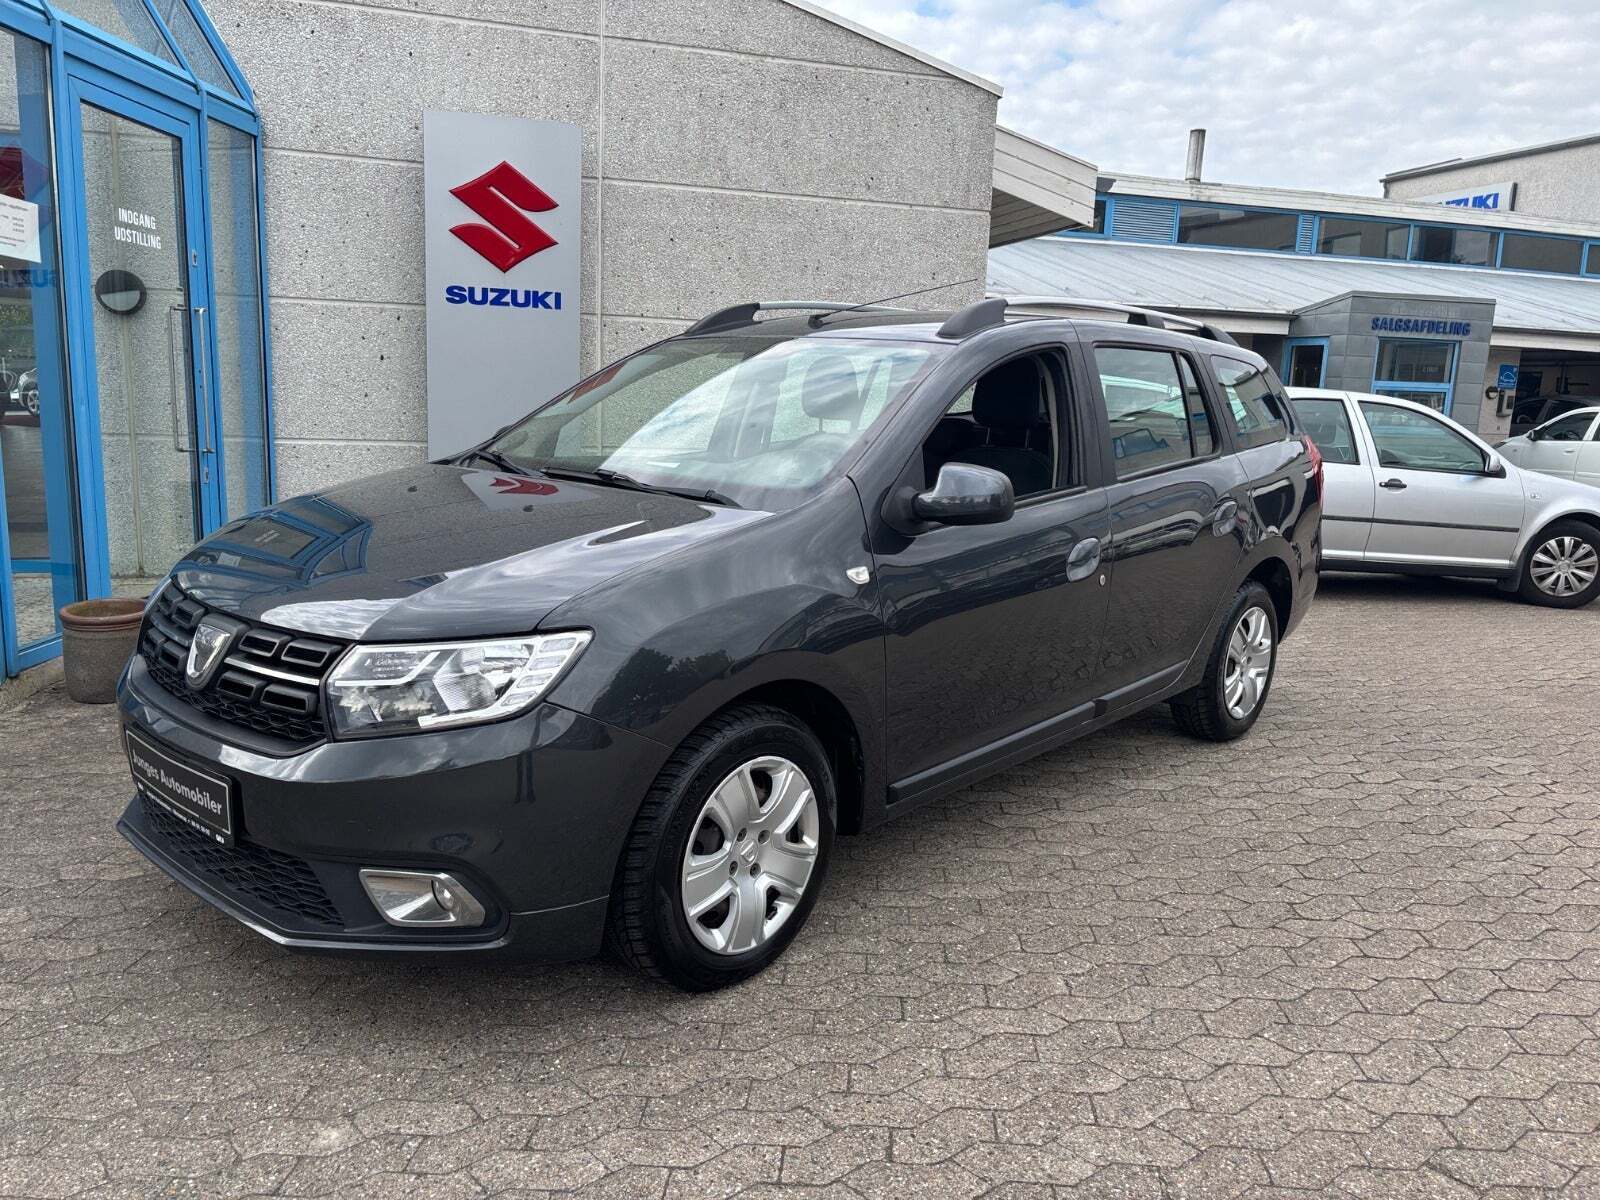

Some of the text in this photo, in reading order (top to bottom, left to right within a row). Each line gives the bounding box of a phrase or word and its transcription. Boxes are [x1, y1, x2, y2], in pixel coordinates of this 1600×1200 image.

[118, 207, 156, 230] INDGANG
[114, 225, 162, 250] UDSTILLING
[445, 285, 562, 311] SUZUKI
[1371, 317, 1471, 336] SALGSAFDELING
[160, 768, 222, 816] Automobiler
